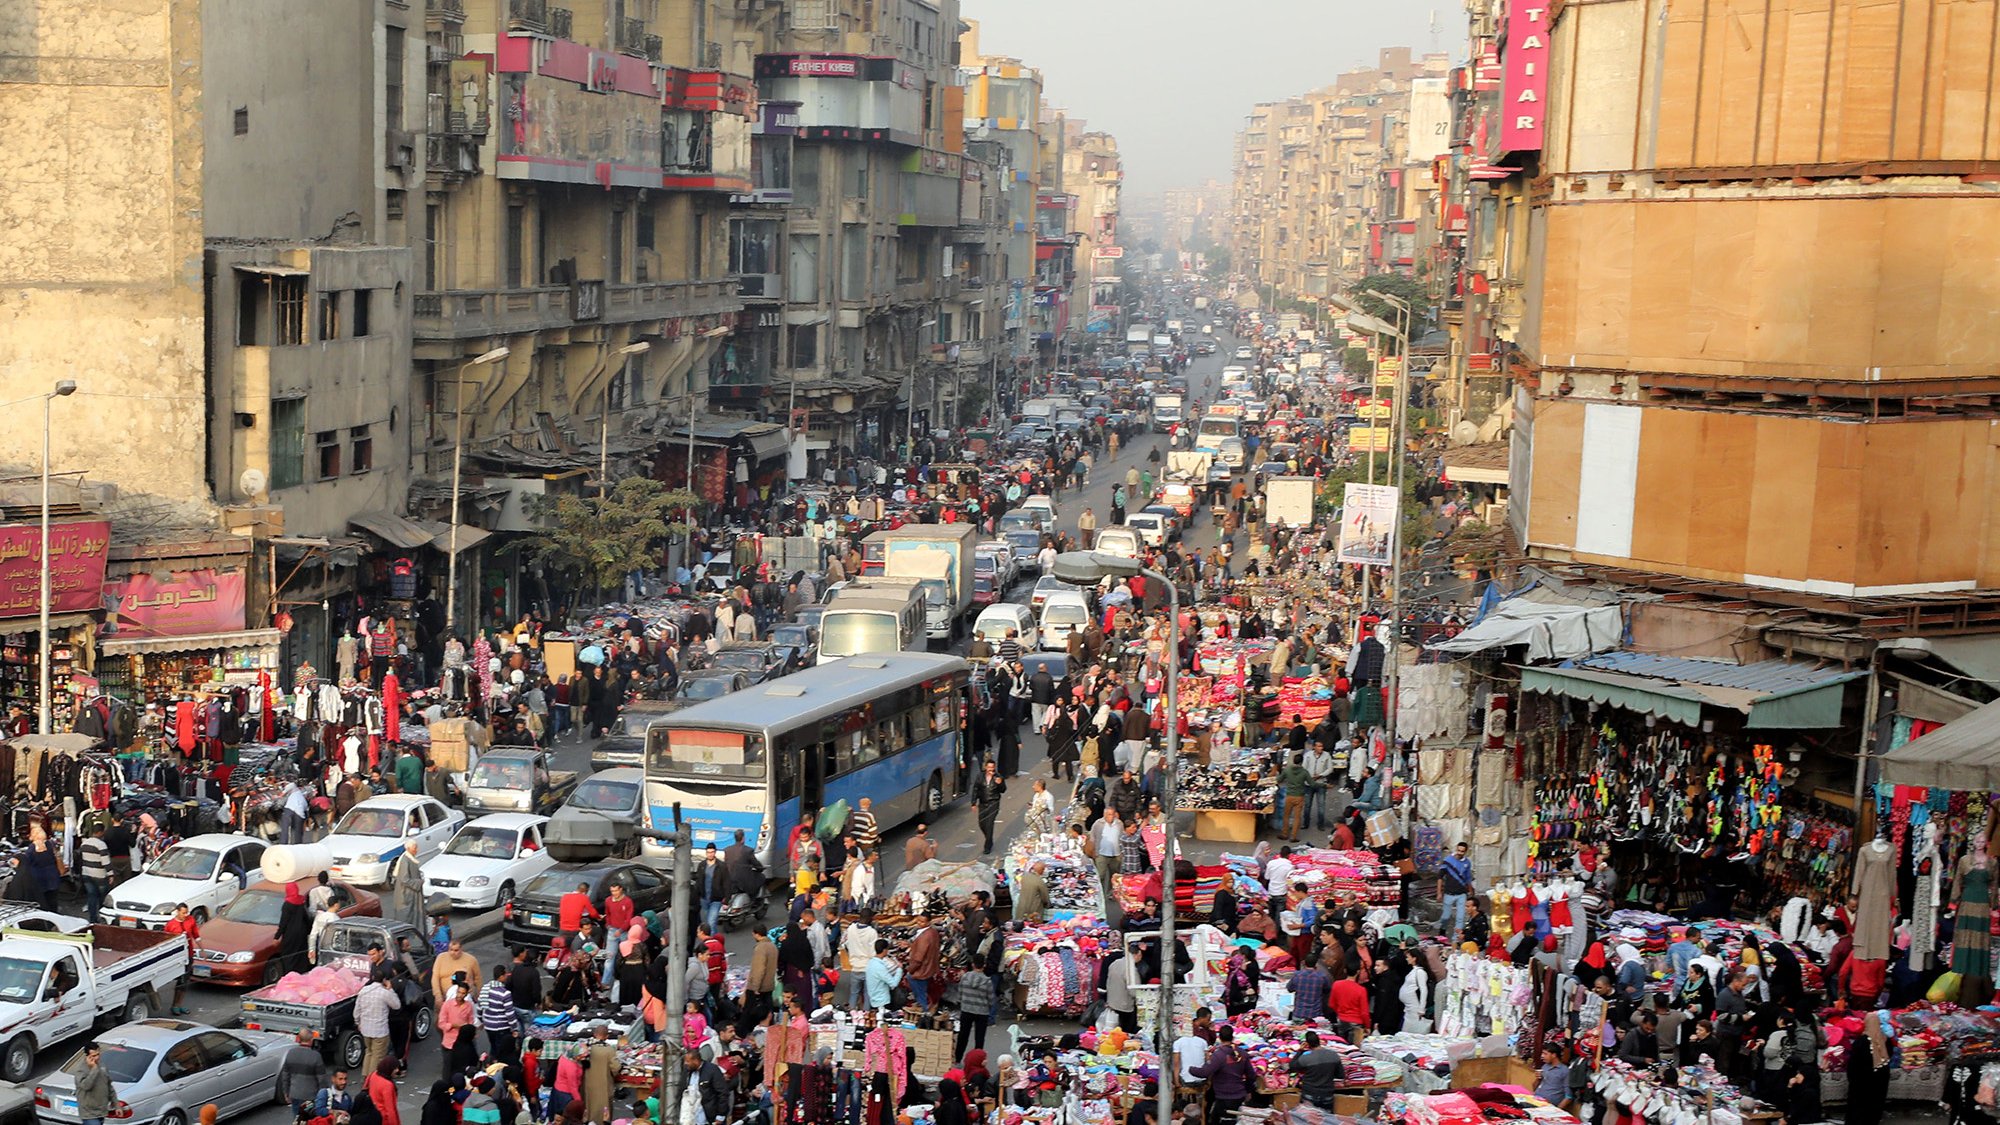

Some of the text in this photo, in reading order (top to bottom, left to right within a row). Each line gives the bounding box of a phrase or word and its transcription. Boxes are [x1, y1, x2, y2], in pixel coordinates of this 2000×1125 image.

[791, 62, 826, 72] FATHET
[1516, 8, 1544, 130] TAIAR
[1435, 121, 1448, 136] 27
[127, 584, 217, 612] الحرمين
[256, 1004, 309, 1017] SUZUKI
